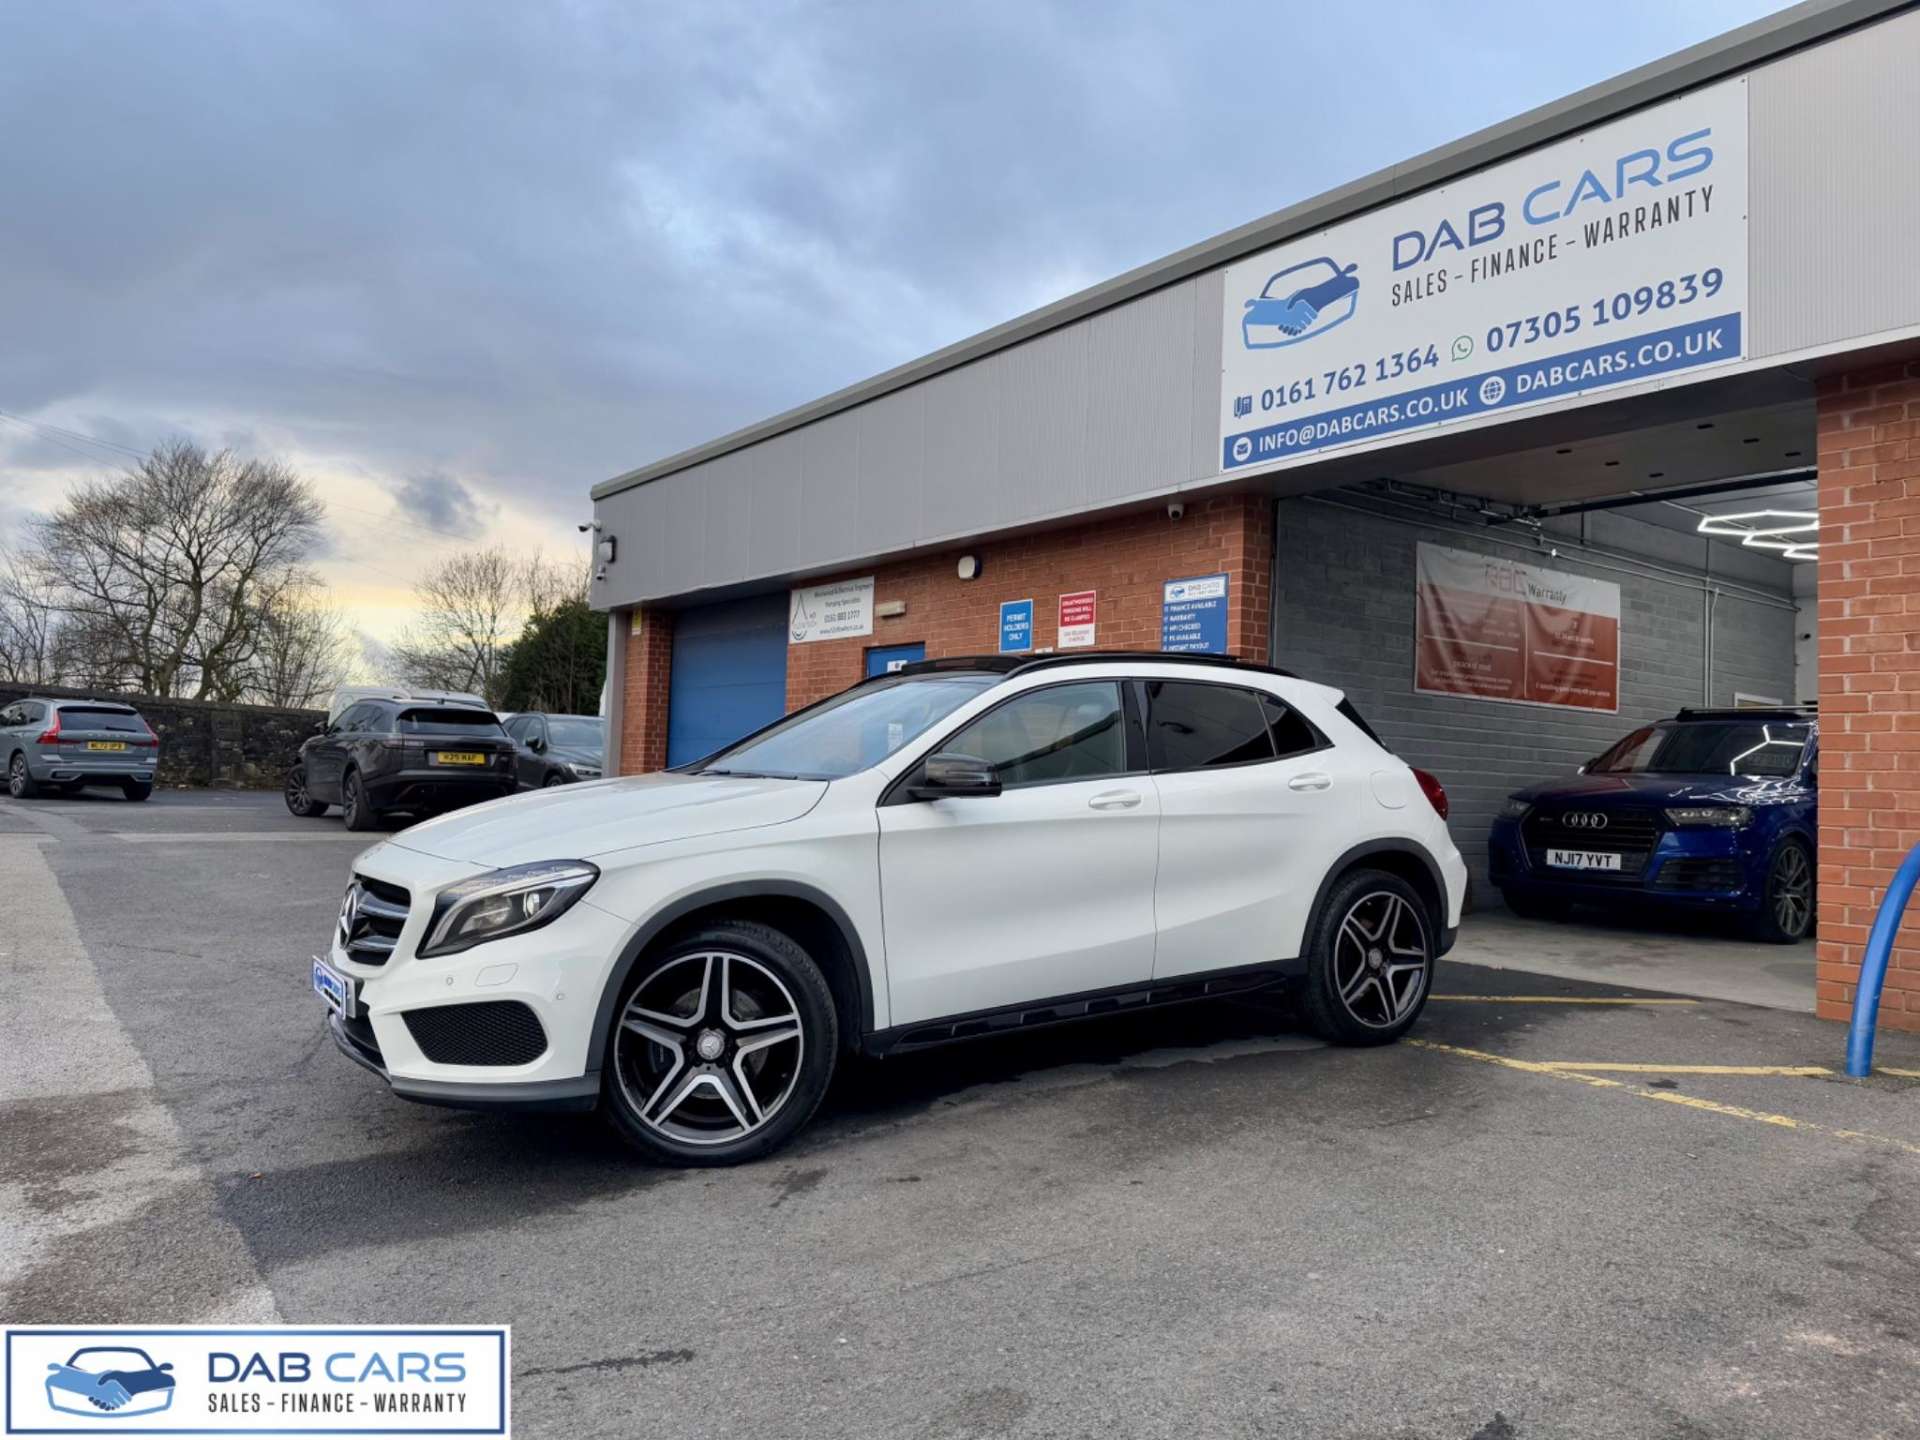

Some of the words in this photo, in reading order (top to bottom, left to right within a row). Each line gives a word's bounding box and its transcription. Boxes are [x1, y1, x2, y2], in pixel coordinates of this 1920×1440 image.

[1392, 201, 1505, 272] DAB
[1523, 127, 1713, 226] CARS
[1392, 270, 1448, 307] SALES
[1471, 234, 1558, 284] FINANCE
[1583, 185, 1714, 249] WARRANTY
[1260, 377, 1316, 412] 0161
[1323, 363, 1367, 400] 762
[1375, 344, 1439, 388] 1364
[1486, 306, 1580, 353] 07305
[1592, 267, 1724, 327] 109839
[1259, 387, 1469, 453] INFO@DABCARS.CO.UK
[1516, 328, 1724, 394] DABCARS.CO.UK
[1528, 583, 1567, 606] Warranty
[1004, 622, 1029, 632] HOLDERS
[1007, 613, 1027, 622] PERMIT
[1008, 632, 1023, 641] ONLY
[1554, 851, 1584, 865] NJ17
